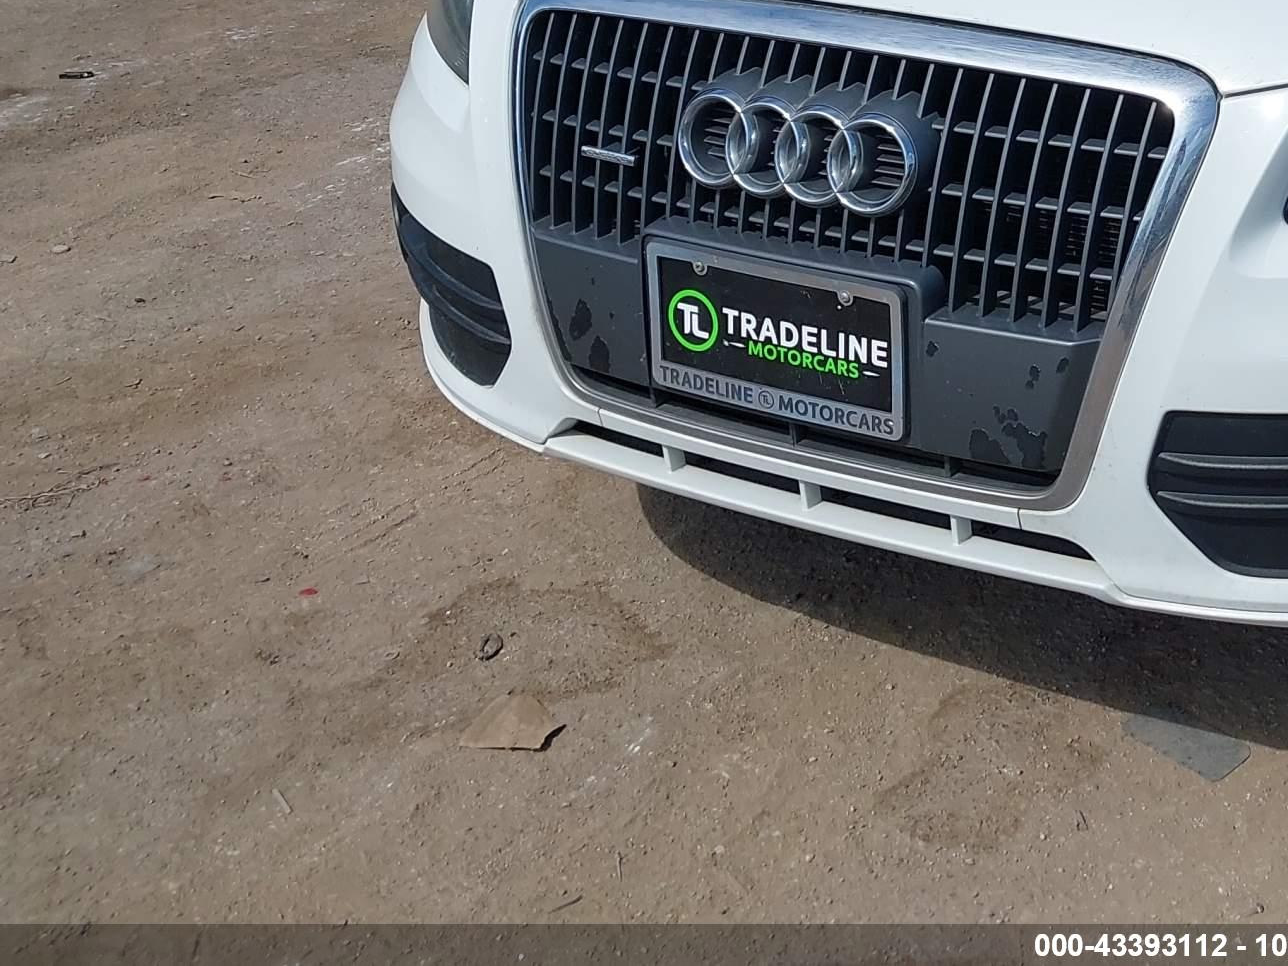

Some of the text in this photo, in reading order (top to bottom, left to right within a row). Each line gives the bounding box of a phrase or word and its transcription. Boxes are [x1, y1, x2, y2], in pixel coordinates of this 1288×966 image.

[722, 307, 889, 369] TRADELINE
[747, 340, 859, 379] MOTORCARS
[659, 365, 753, 404] TRADELINE
[778, 395, 895, 435] MOTORCARS
